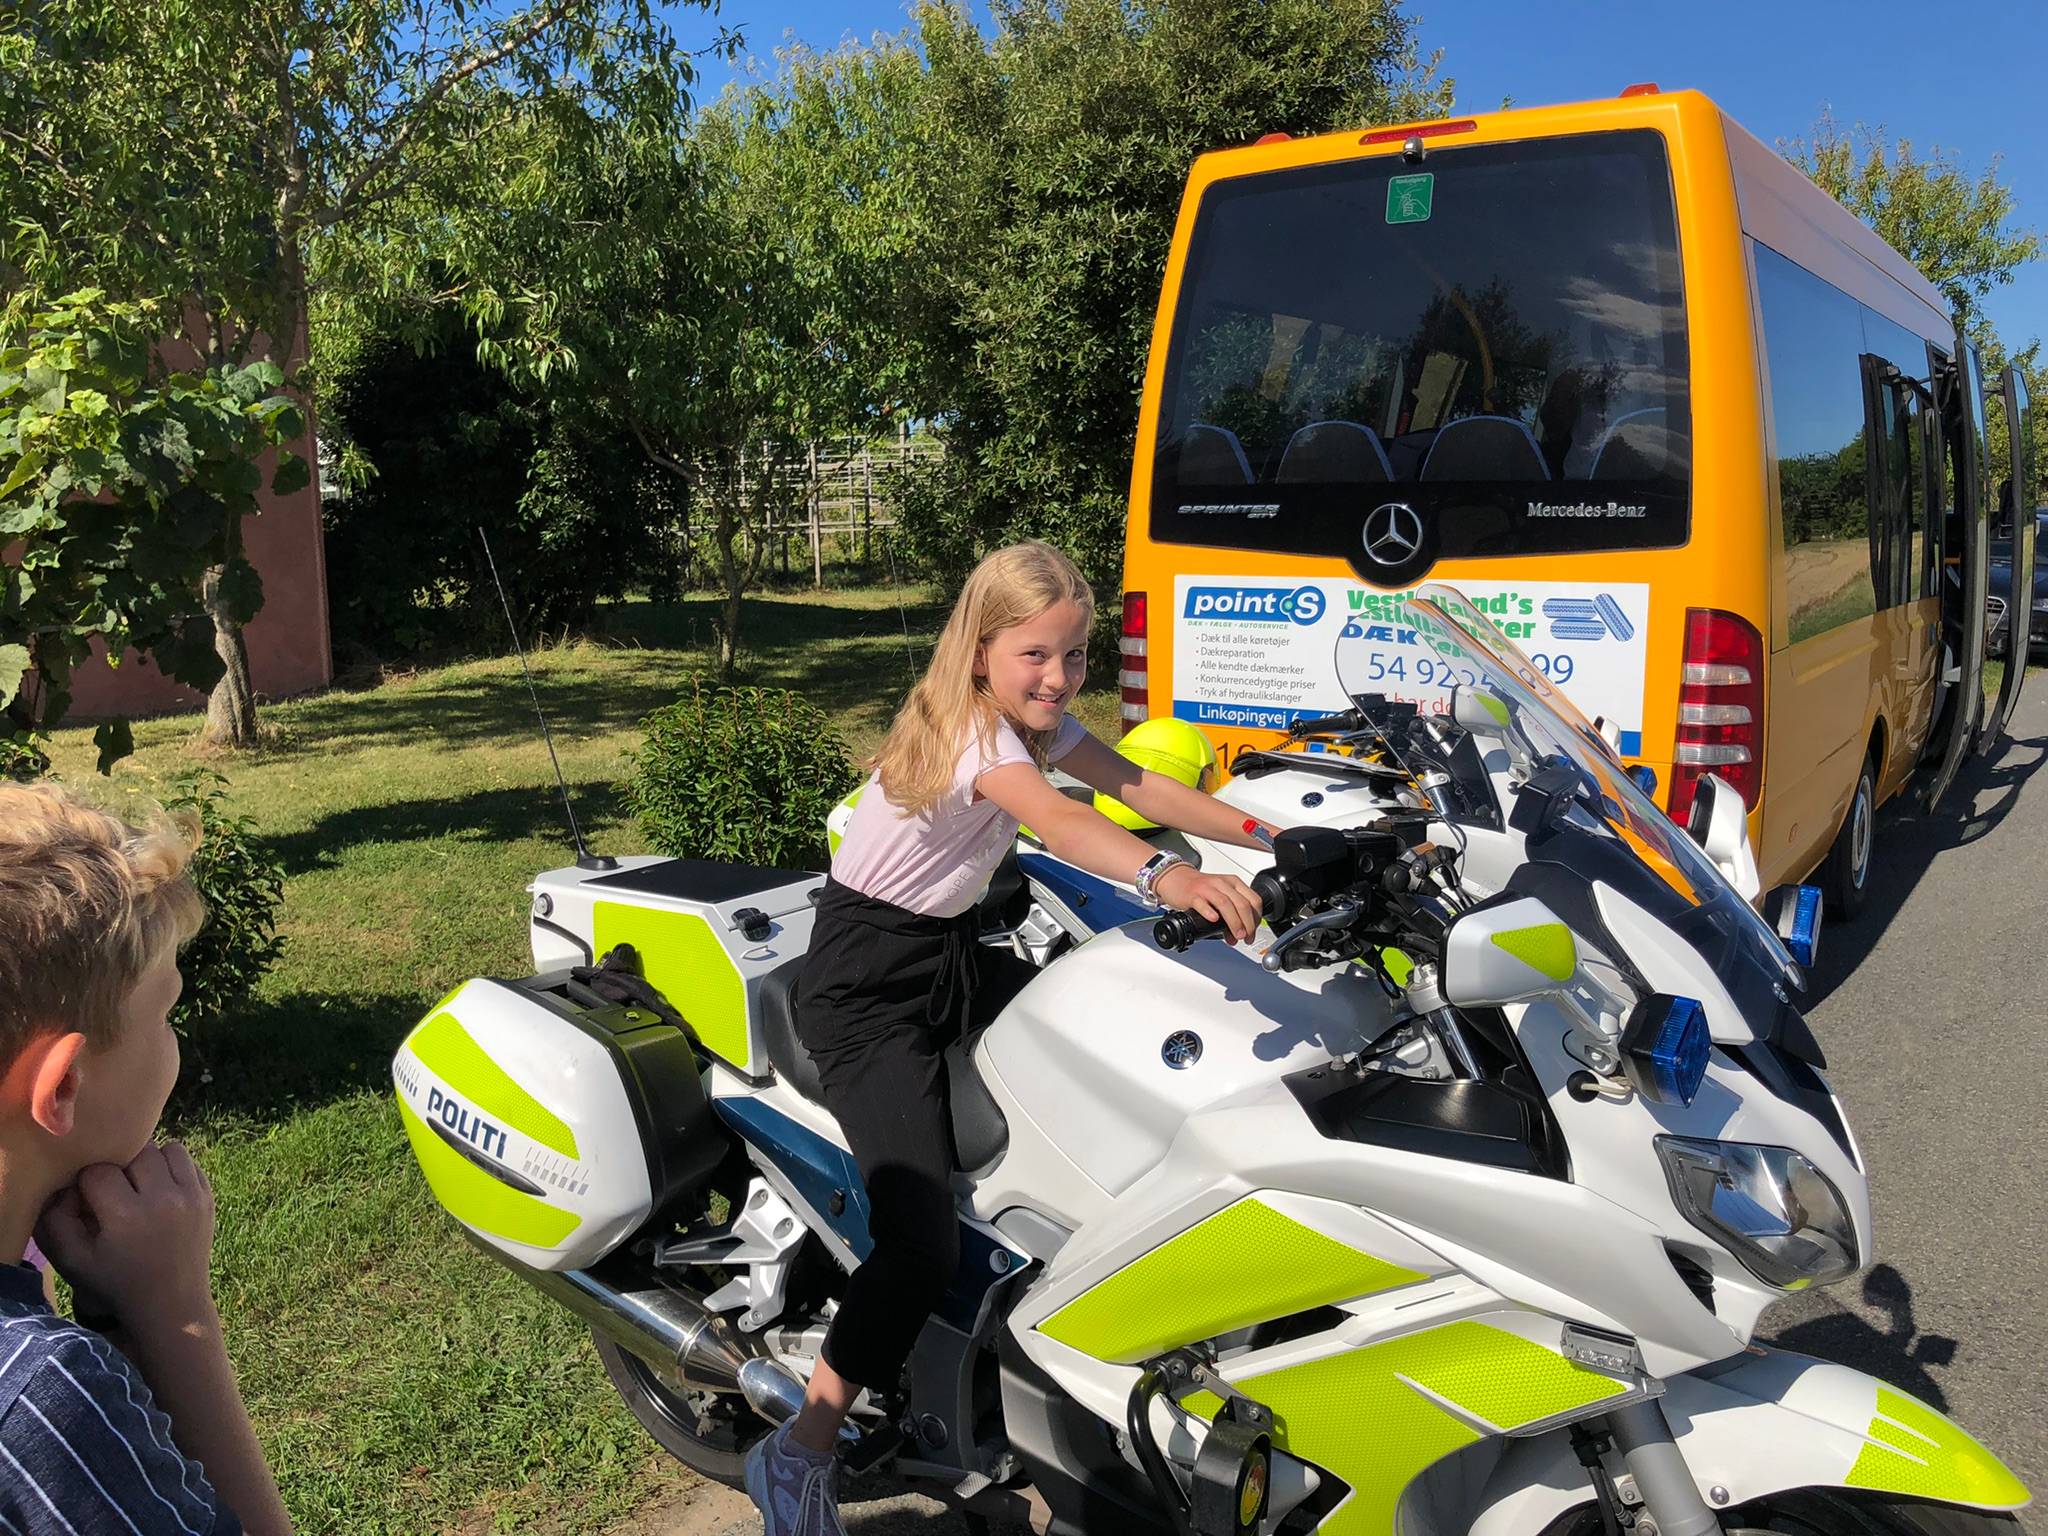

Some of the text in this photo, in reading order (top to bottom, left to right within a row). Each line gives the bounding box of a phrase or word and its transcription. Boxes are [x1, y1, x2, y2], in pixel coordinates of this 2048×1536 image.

[1177, 504, 1281, 514] SPRINTER
[1526, 502, 1647, 518] Mercedes-Benz
[1193, 591, 1320, 619] point S
[1239, 622, 1289, 630] AUTOSERVICE
[1341, 619, 1418, 645] DÆK
[1200, 633, 1290, 648] Dæk til alle køretøjer
[1200, 647, 1265, 659] Dækreparation
[1200, 660, 1305, 675] Alle kendte dækmærker
[1367, 652, 1407, 682] 54
[1415, 658, 1455, 689] 92
[1199, 673, 1316, 690] Konkurrencedygtige priser
[1199, 687, 1302, 704] Tryk af hydraulikslanger
[1198, 703, 1286, 729] Linkøpingvej
[426, 1085, 508, 1160] POLITI
